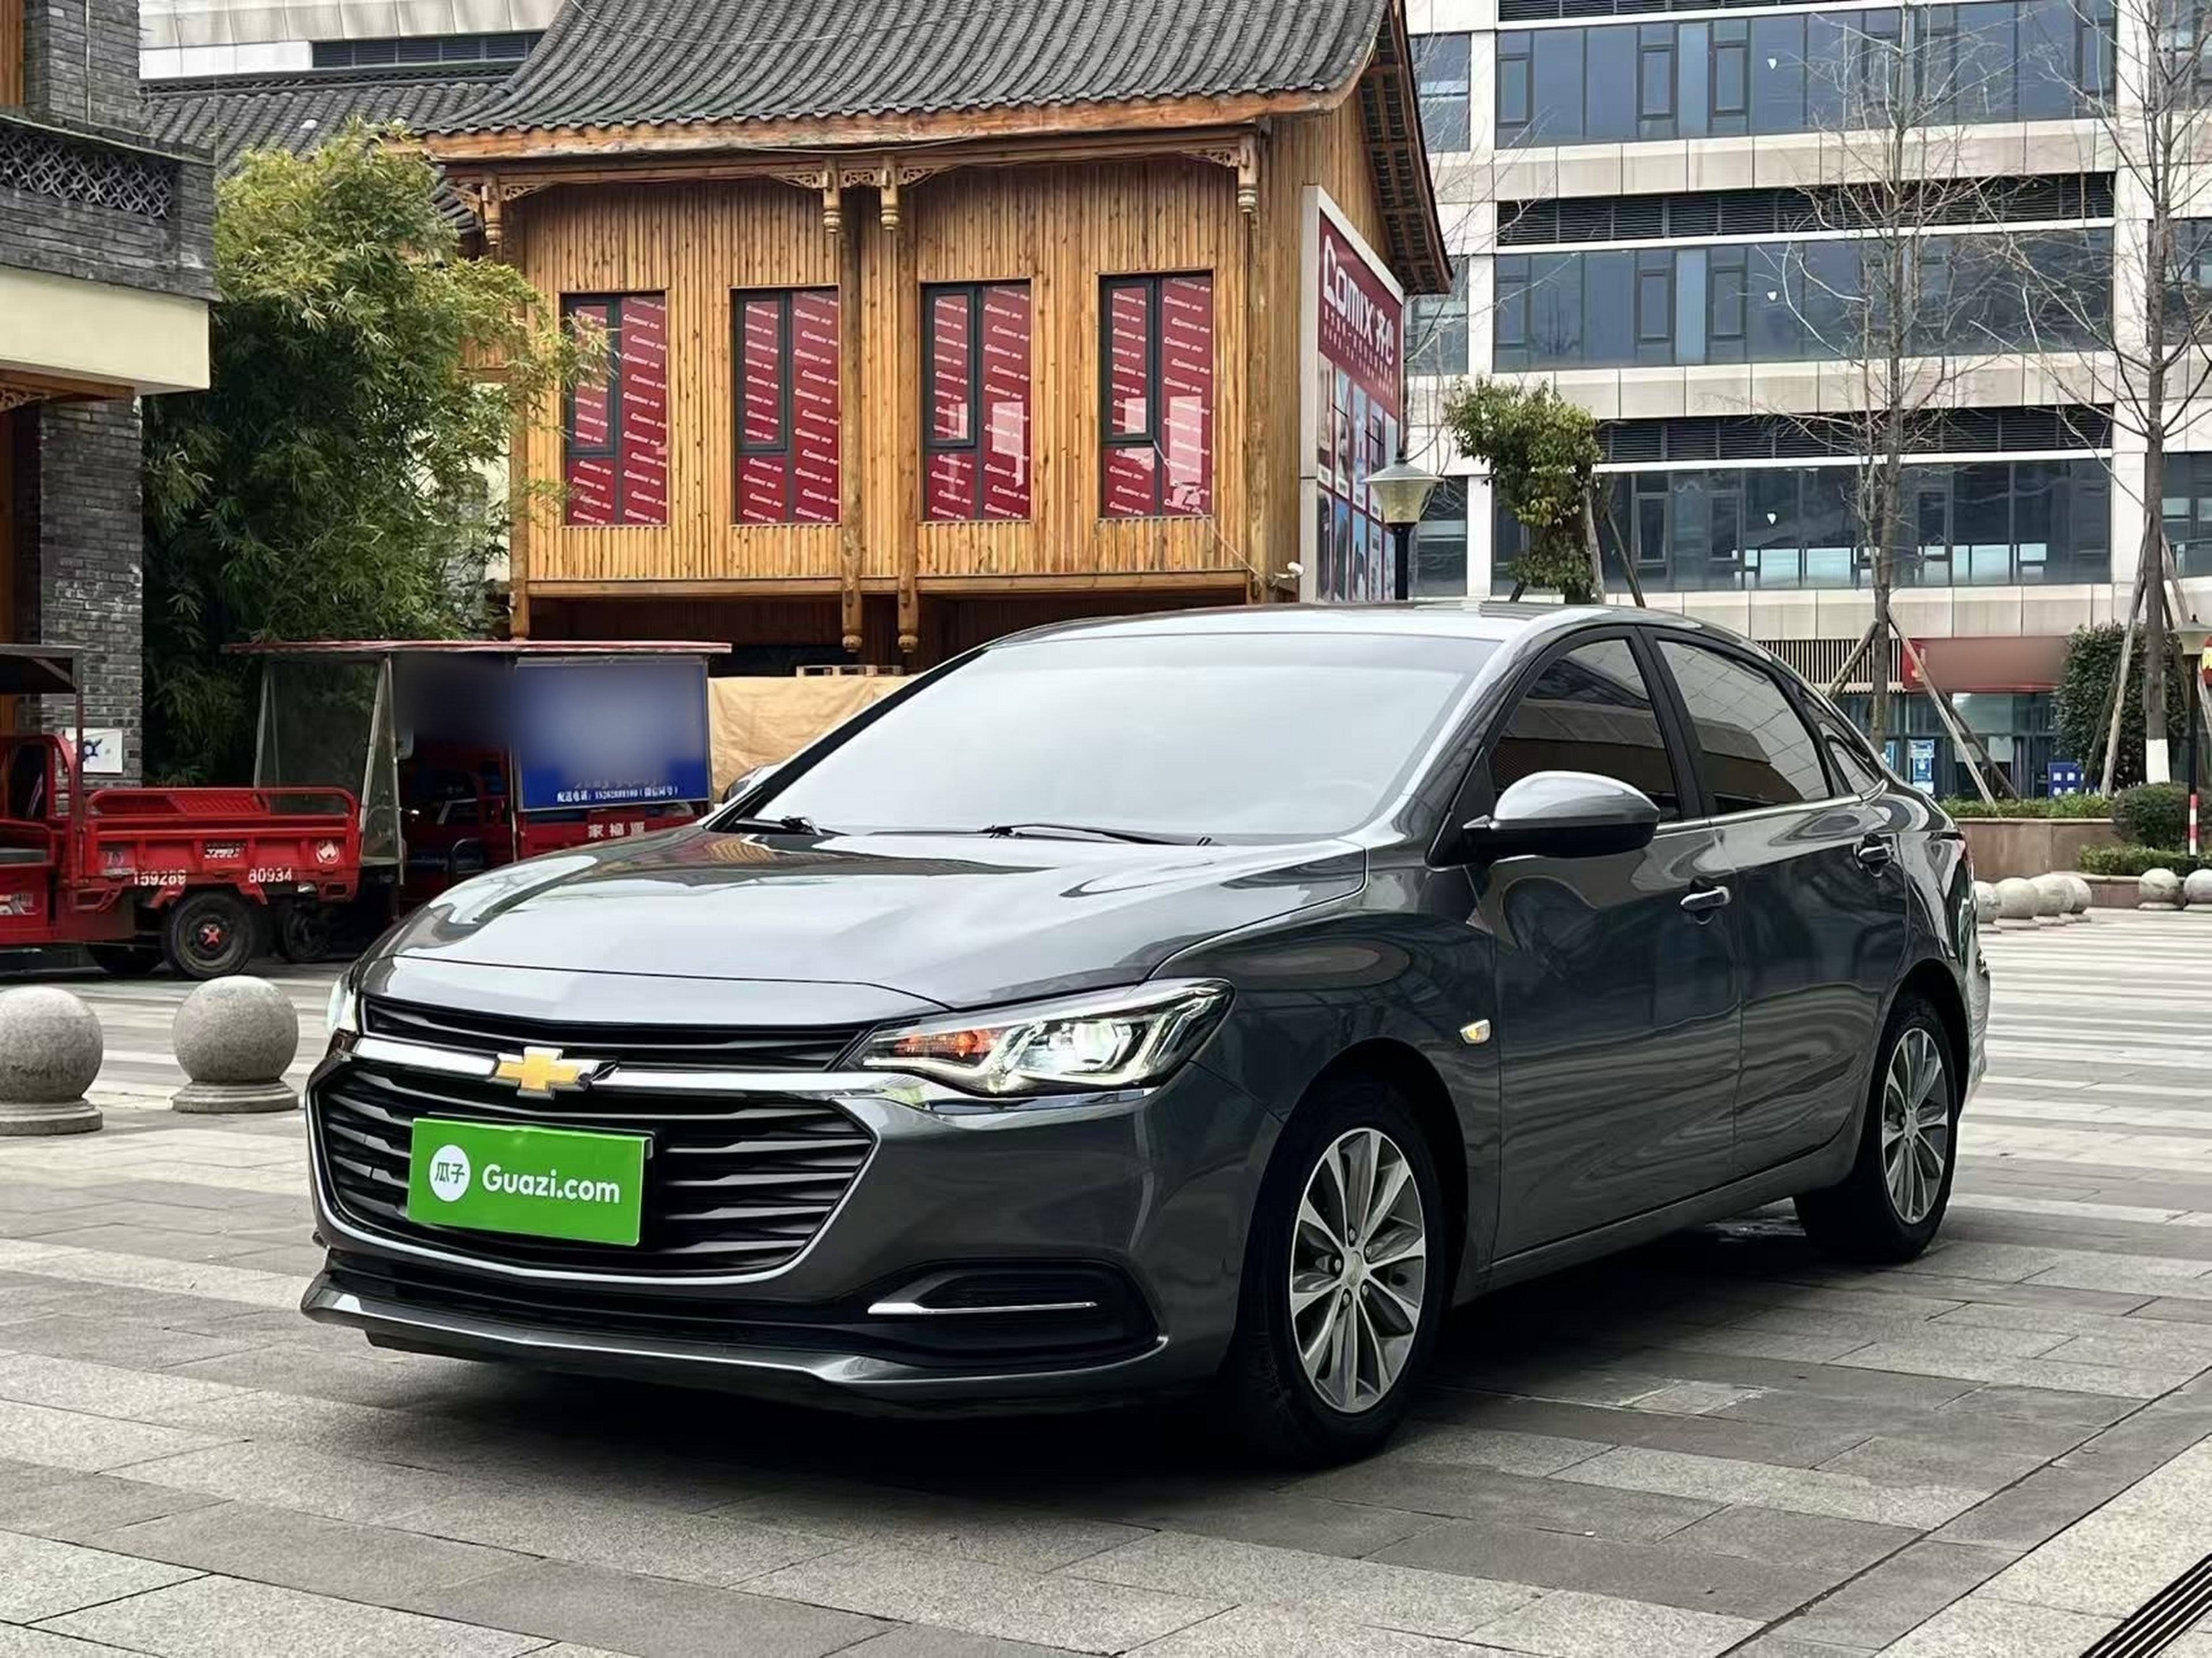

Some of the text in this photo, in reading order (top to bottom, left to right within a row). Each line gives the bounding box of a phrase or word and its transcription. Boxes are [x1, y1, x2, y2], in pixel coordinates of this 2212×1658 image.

[1324, 234, 1374, 346] Comix
[248, 867, 292, 883] 80934
[434, 1162, 465, 1184] 瓜子
[482, 1163, 620, 1204] Guazi.com
